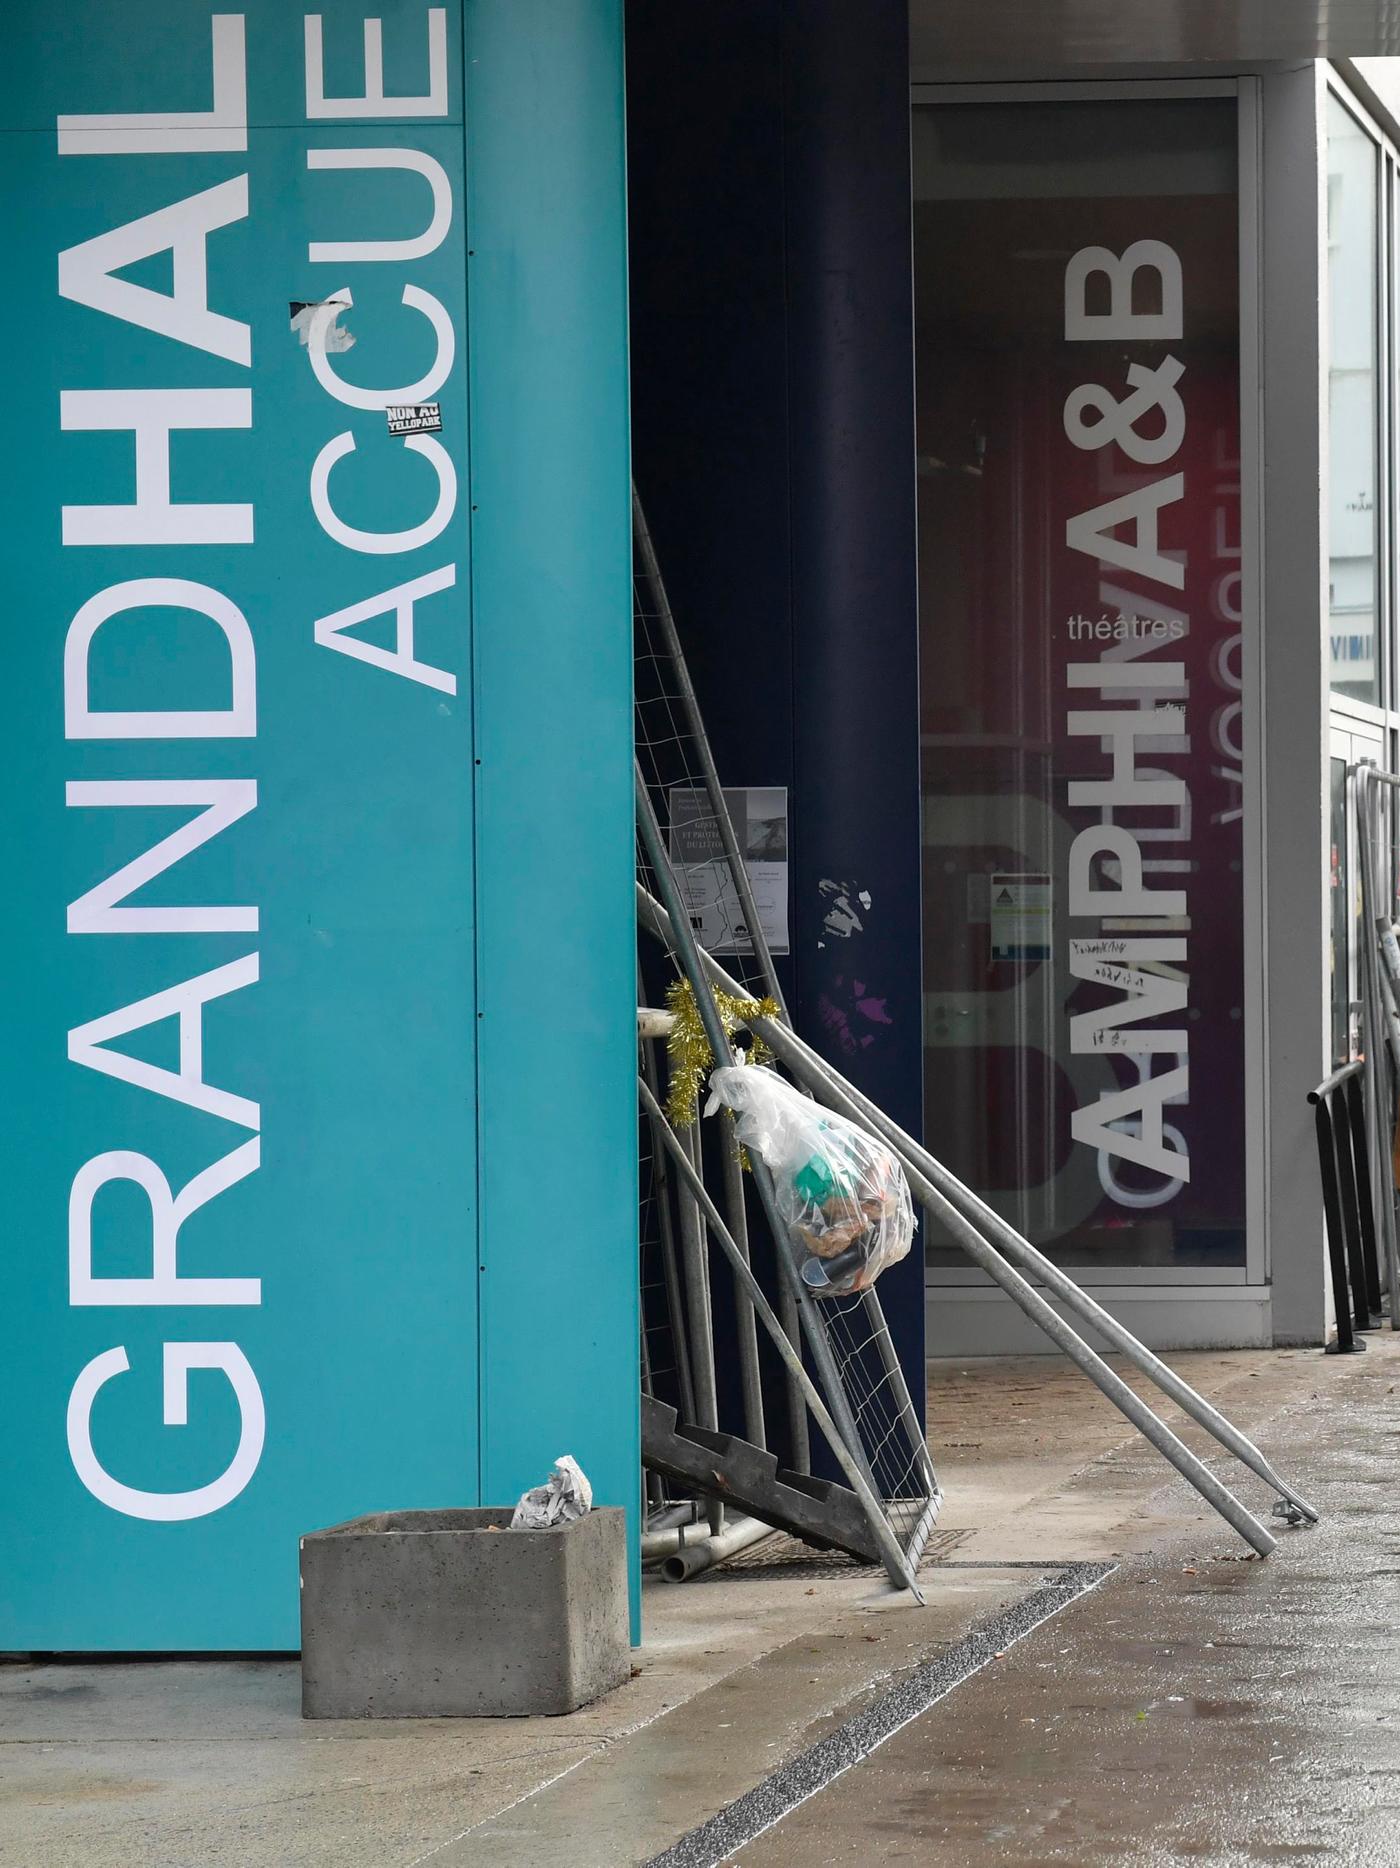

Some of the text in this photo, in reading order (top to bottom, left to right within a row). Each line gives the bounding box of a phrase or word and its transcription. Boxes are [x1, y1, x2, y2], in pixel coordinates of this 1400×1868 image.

[386, 406, 417, 422] NON
[388, 415, 442, 431] YELLOPARK
[1067, 614, 1185, 640] théâtres
[1066, 661, 1191, 1184] AMPHI
